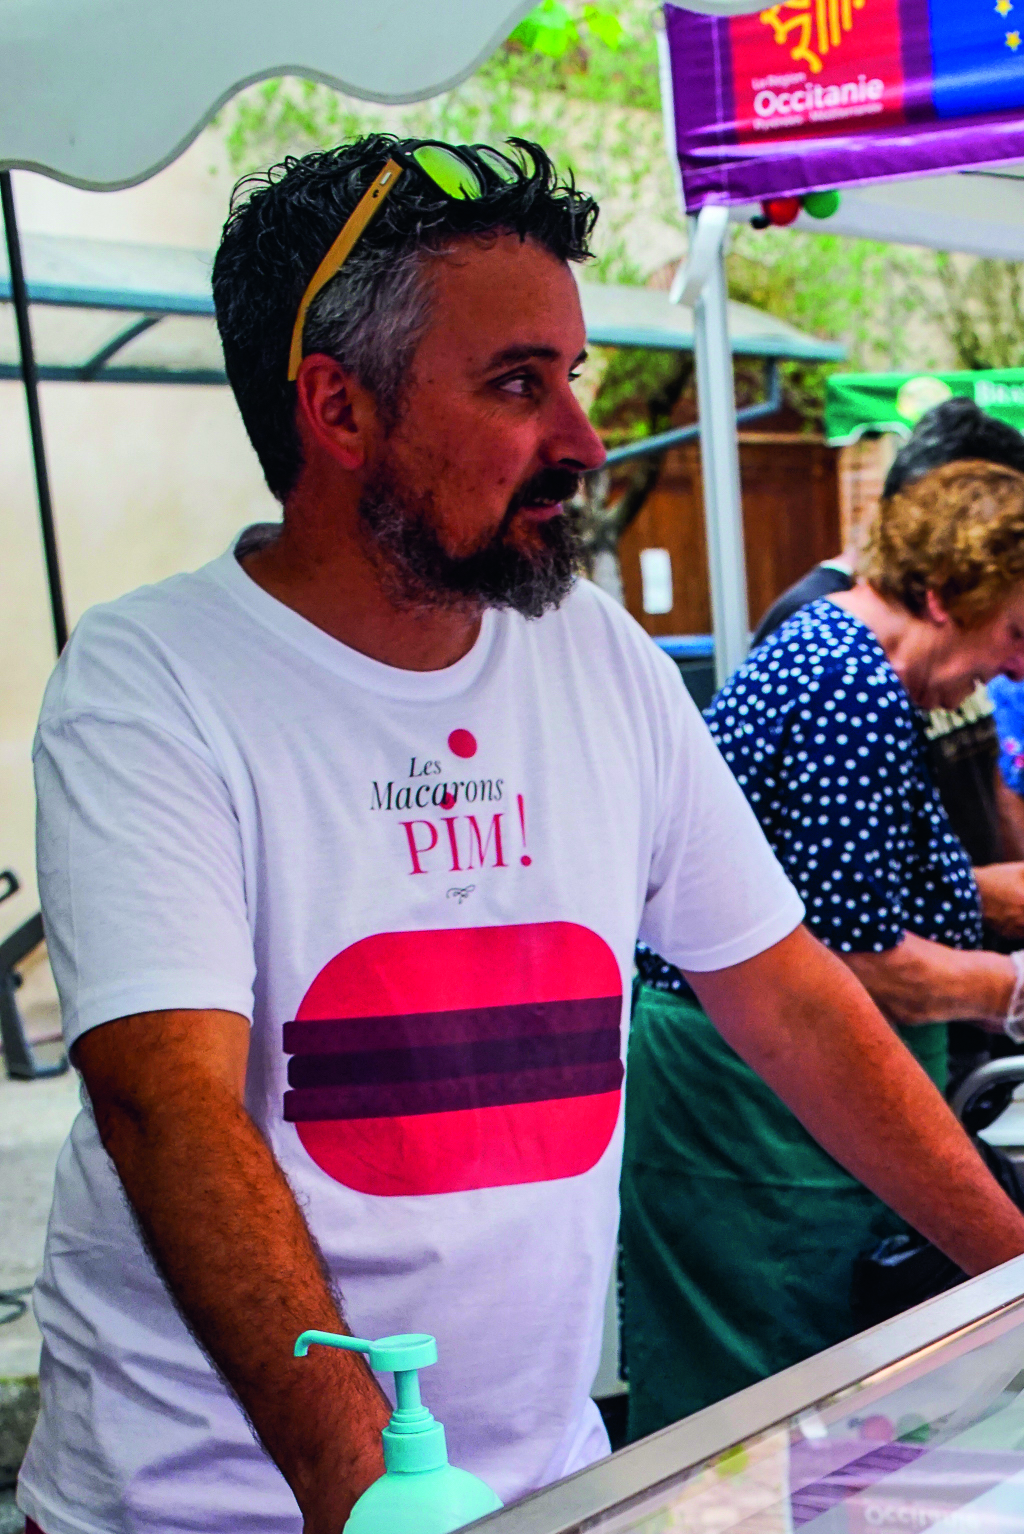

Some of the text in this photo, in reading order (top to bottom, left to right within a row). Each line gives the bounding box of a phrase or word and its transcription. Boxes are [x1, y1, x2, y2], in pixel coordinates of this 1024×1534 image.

[754, 74, 884, 117] Occitanie
[408, 757, 442, 778] Les
[369, 778, 504, 811] Macarons
